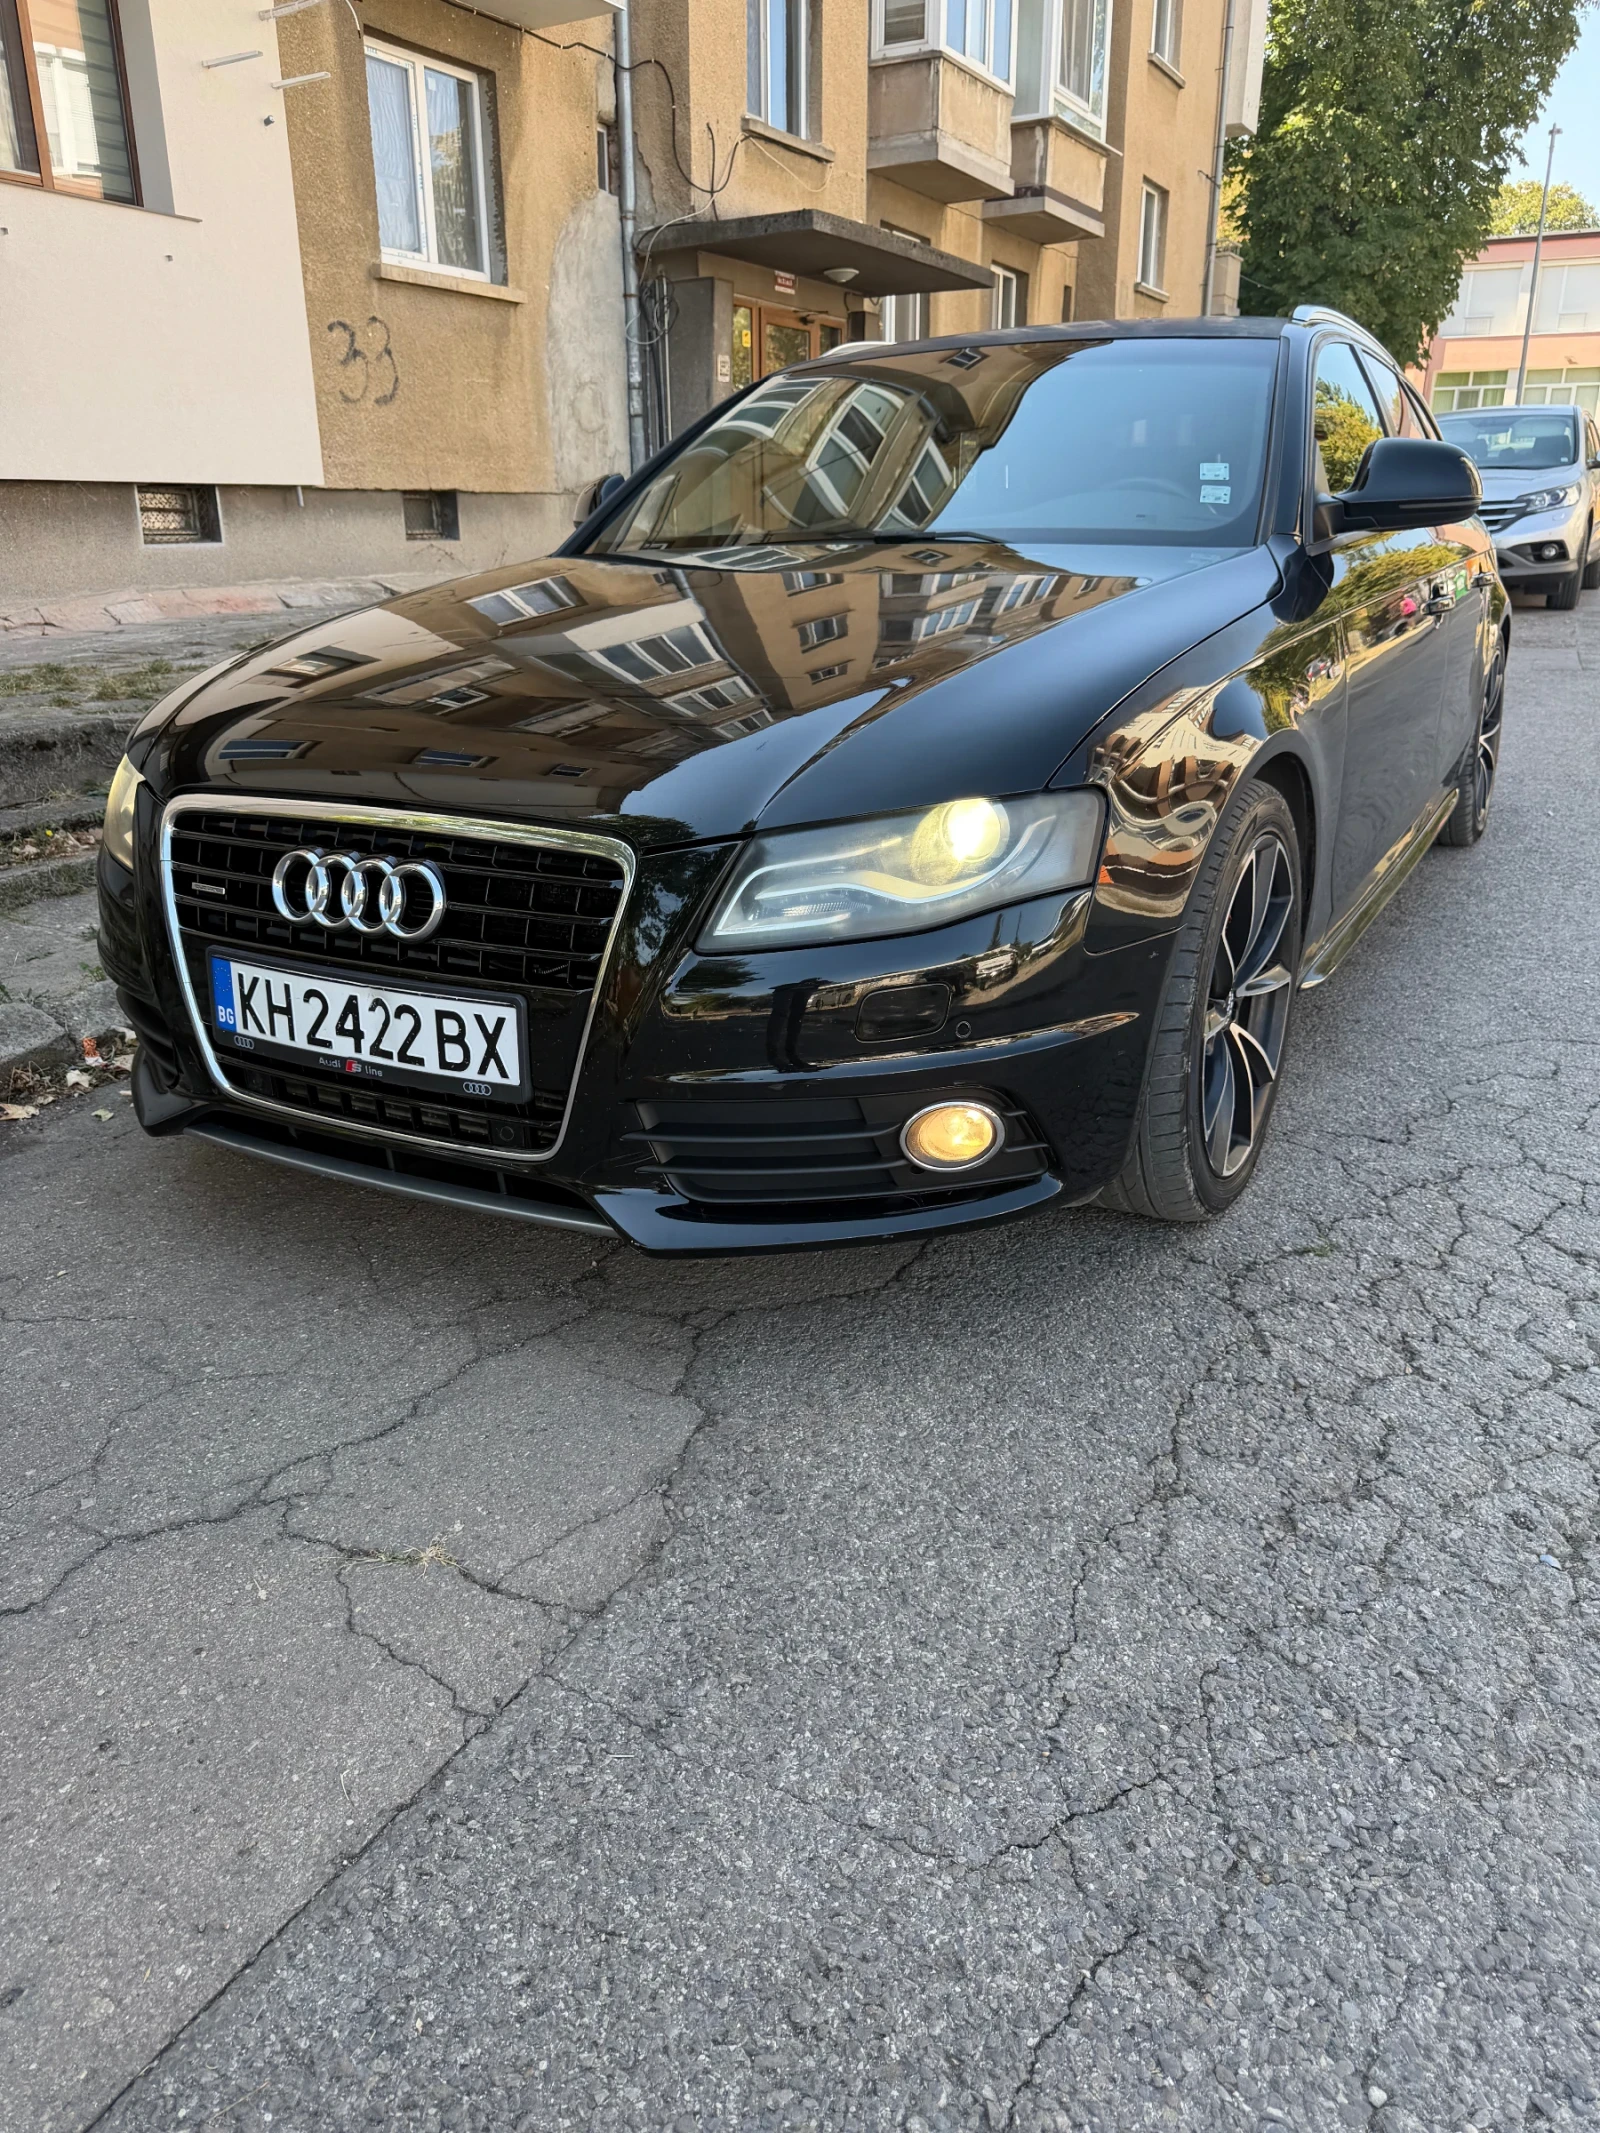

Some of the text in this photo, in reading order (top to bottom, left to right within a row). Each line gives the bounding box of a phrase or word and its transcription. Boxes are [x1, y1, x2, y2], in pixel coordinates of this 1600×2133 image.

[217, 1005, 235, 1025] BG
[318, 1056, 342, 1069] Audi
[364, 1065, 383, 1077] line
